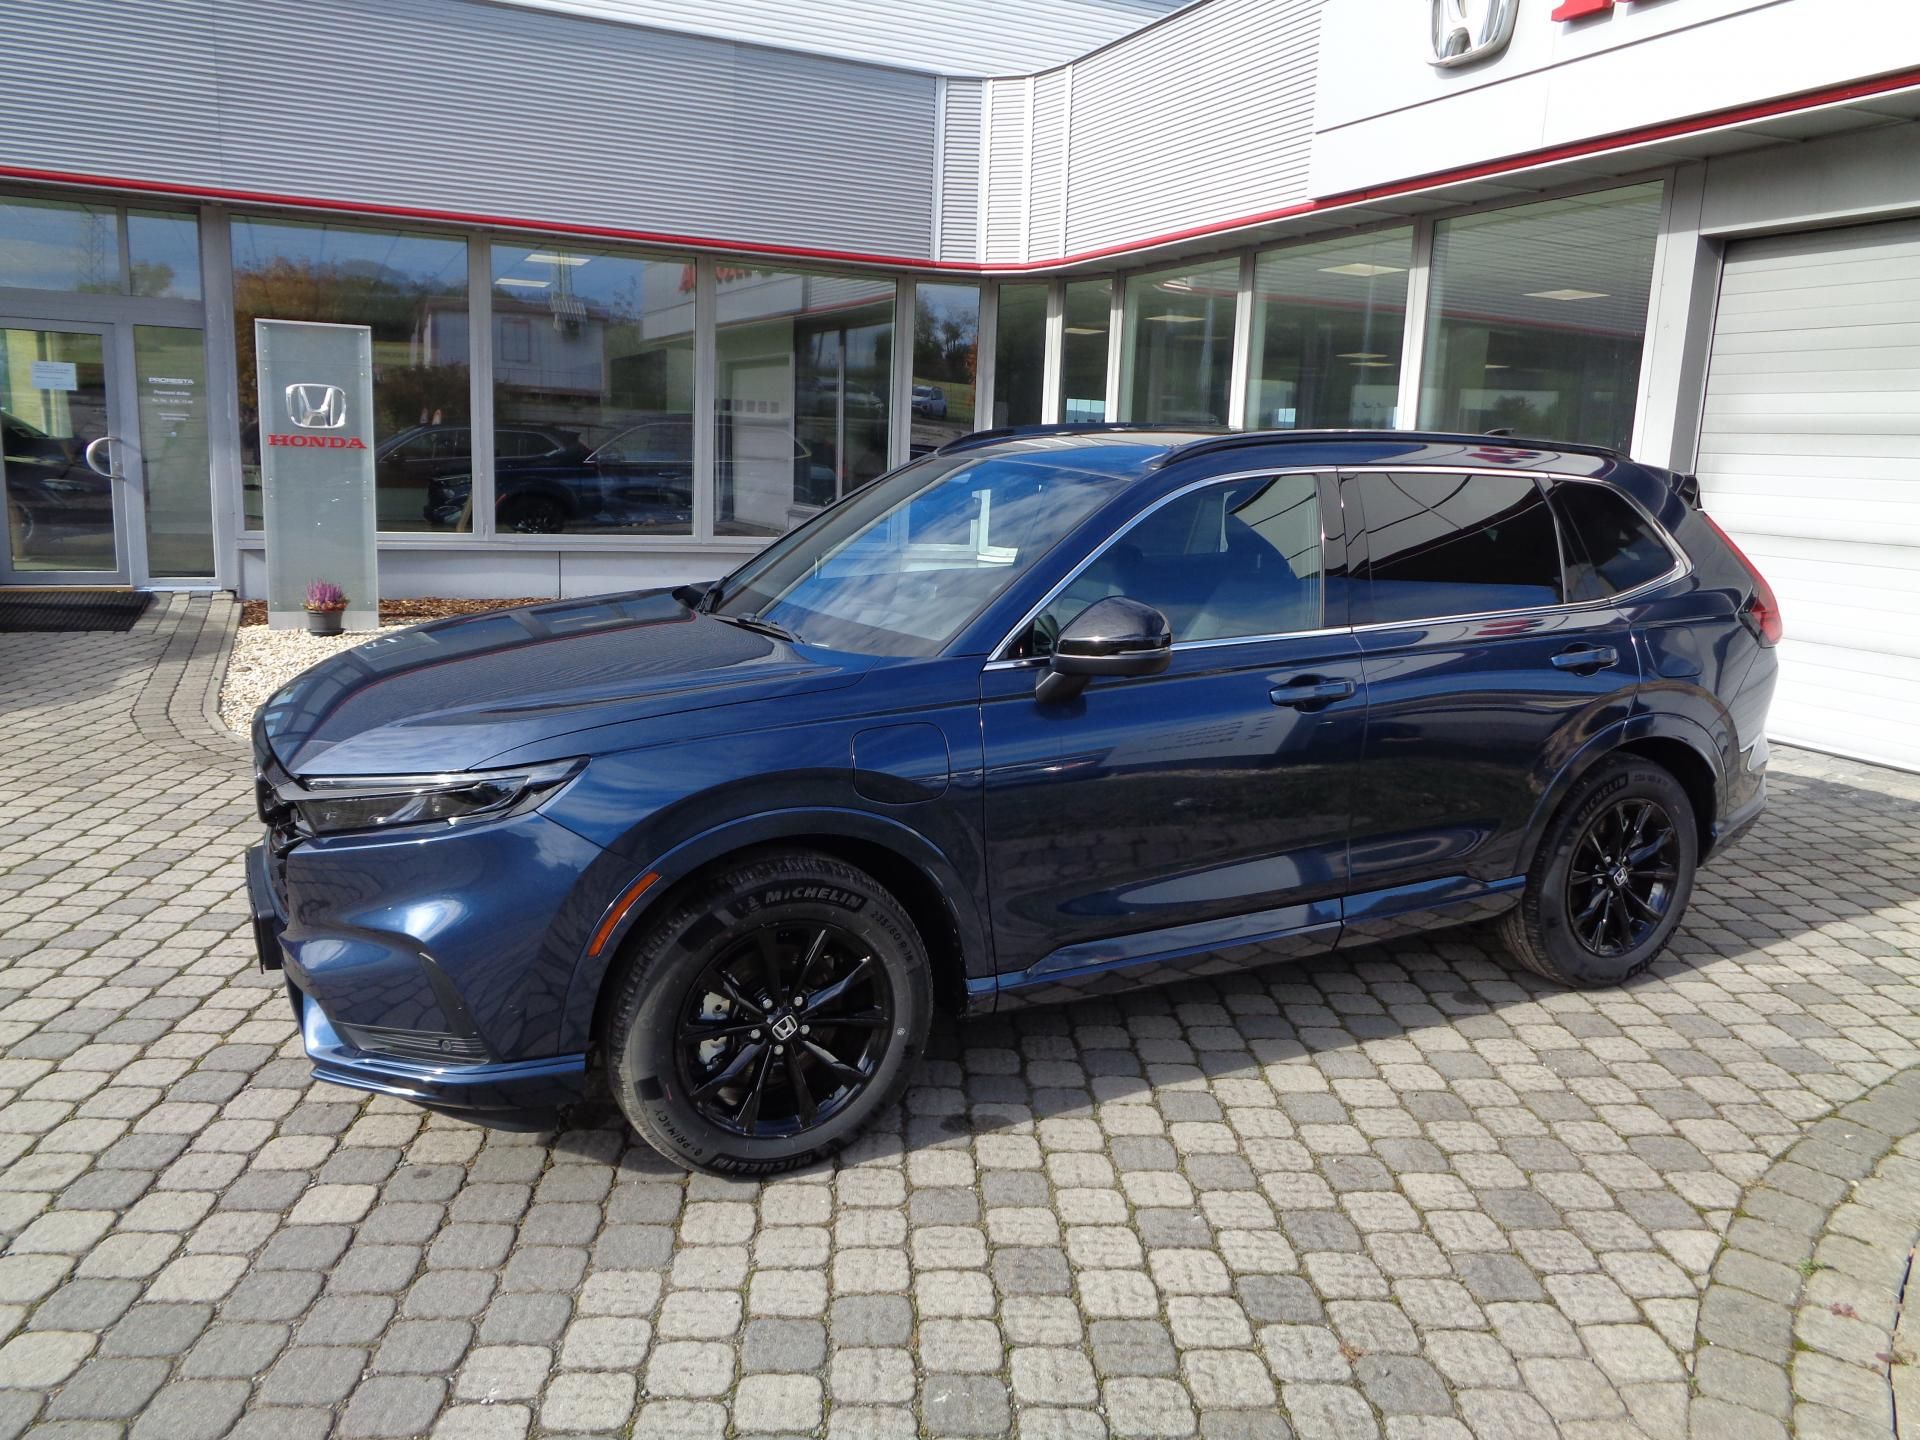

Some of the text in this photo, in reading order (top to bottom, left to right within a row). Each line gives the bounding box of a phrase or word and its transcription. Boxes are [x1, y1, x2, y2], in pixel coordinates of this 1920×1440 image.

[267, 433, 367, 450] HONDA
[765, 886, 863, 911] MICHELIN
[870, 909, 901, 941] 235/60
[712, 1152, 813, 1175] MICHELIN
